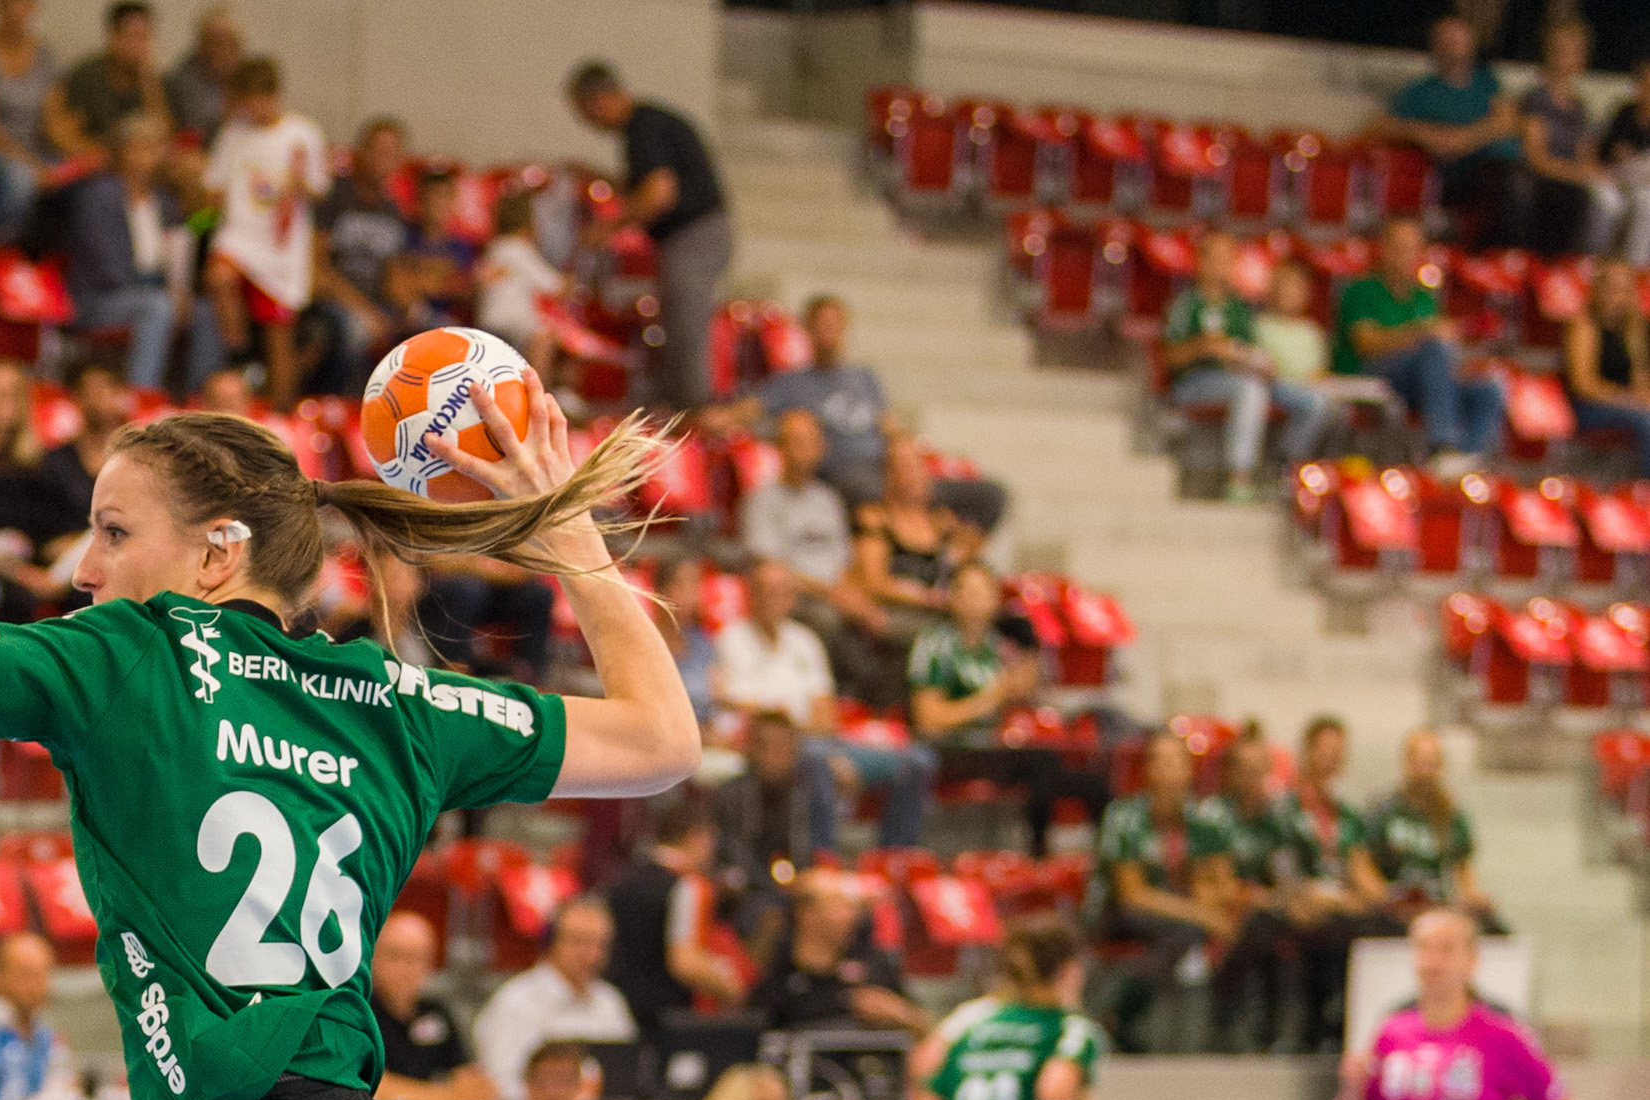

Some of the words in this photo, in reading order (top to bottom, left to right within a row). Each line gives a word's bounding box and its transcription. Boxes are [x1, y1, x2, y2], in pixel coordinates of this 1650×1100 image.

[301, 672, 393, 708] KLINIK
[216, 719, 359, 788] Murer
[197, 790, 363, 989] 26
